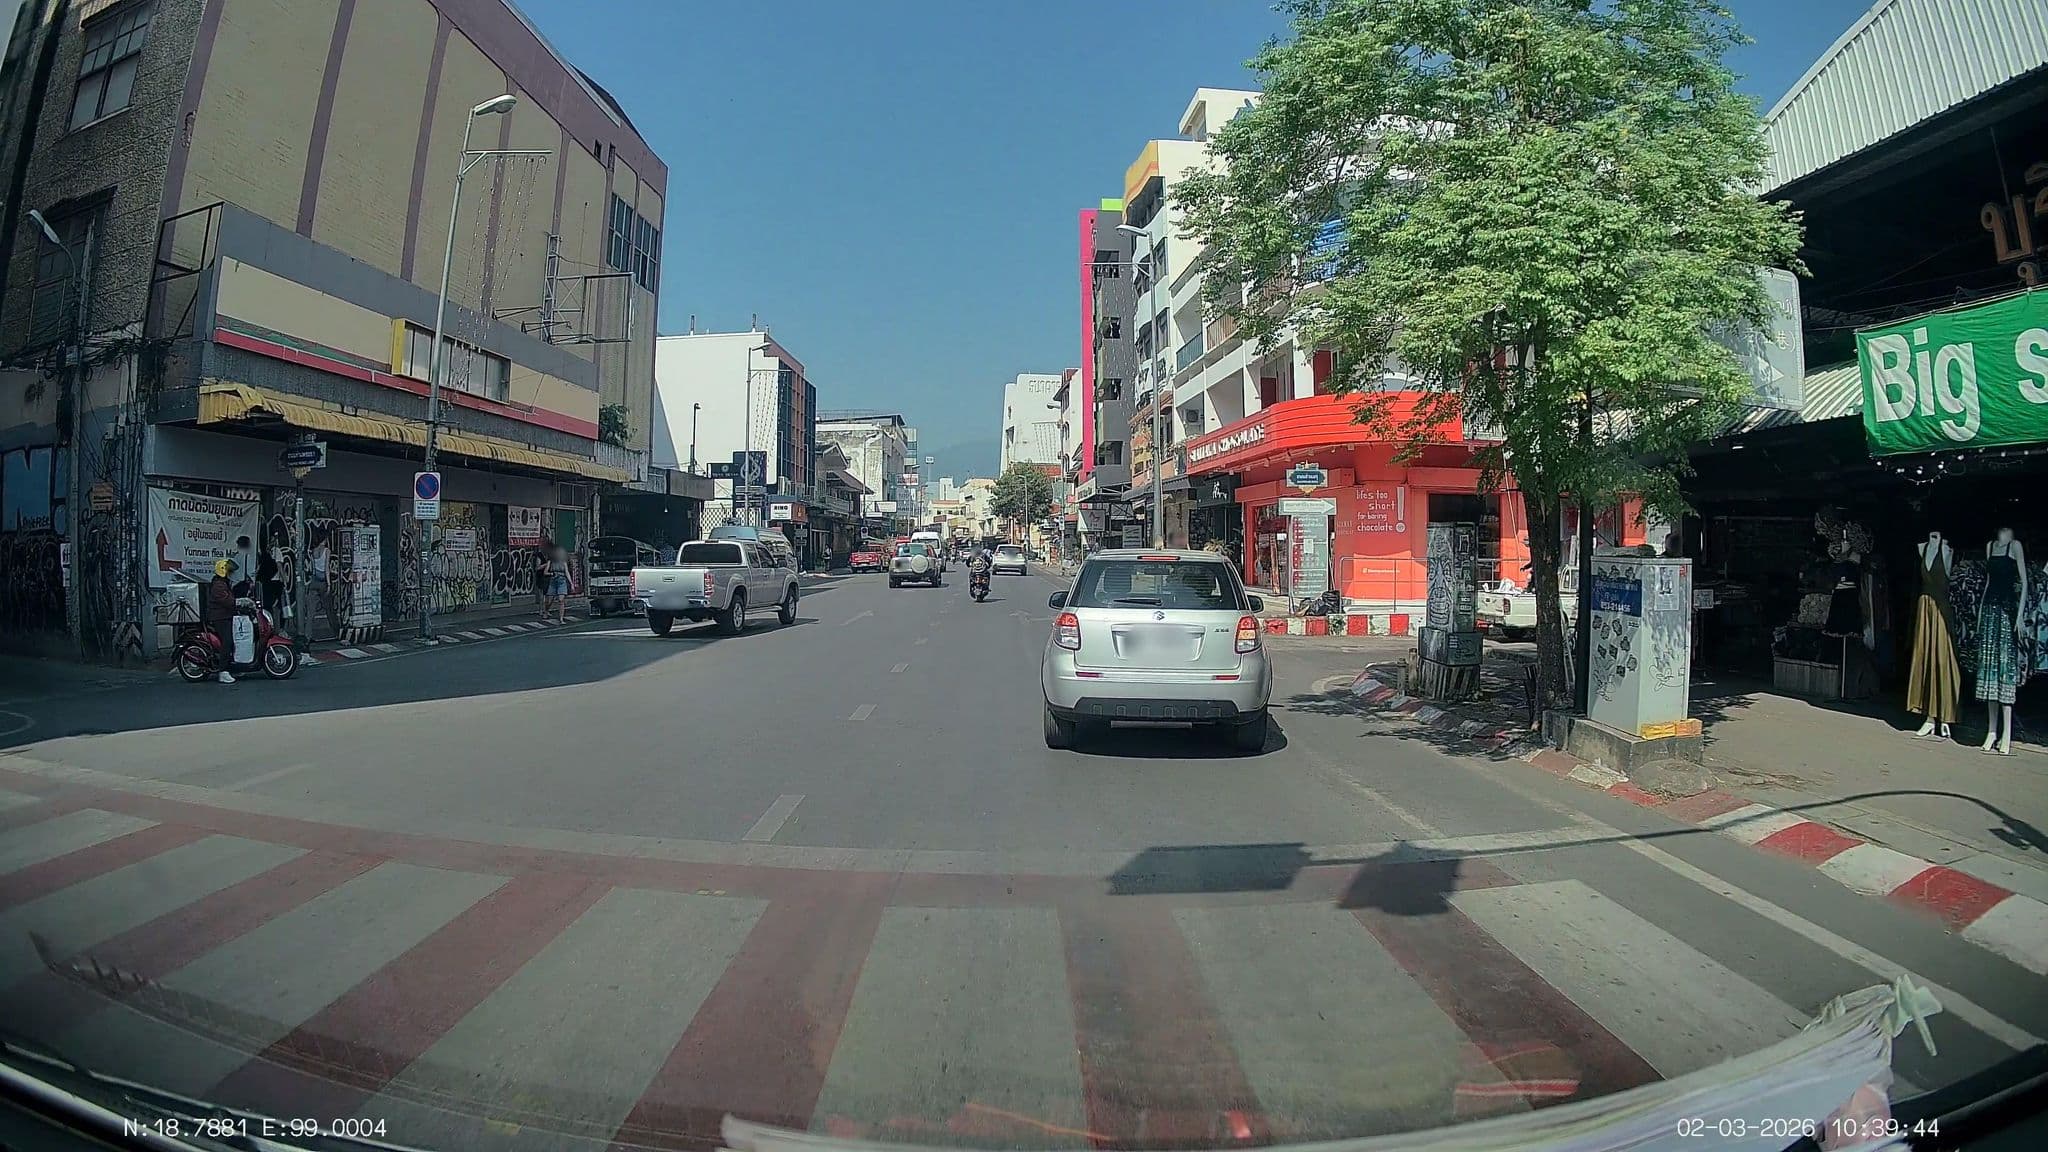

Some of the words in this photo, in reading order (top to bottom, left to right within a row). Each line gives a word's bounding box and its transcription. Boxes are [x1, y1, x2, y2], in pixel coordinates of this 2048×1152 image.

[1868, 327, 1981, 442] Big
[1356, 489, 1374, 500] life's
[1376, 490, 1388, 499] too
[1368, 500, 1395, 510] short
[1367, 511, 1388, 521] boring
[1357, 522, 1393, 532] chocolate
[184, 546, 210, 557] Yunnan
